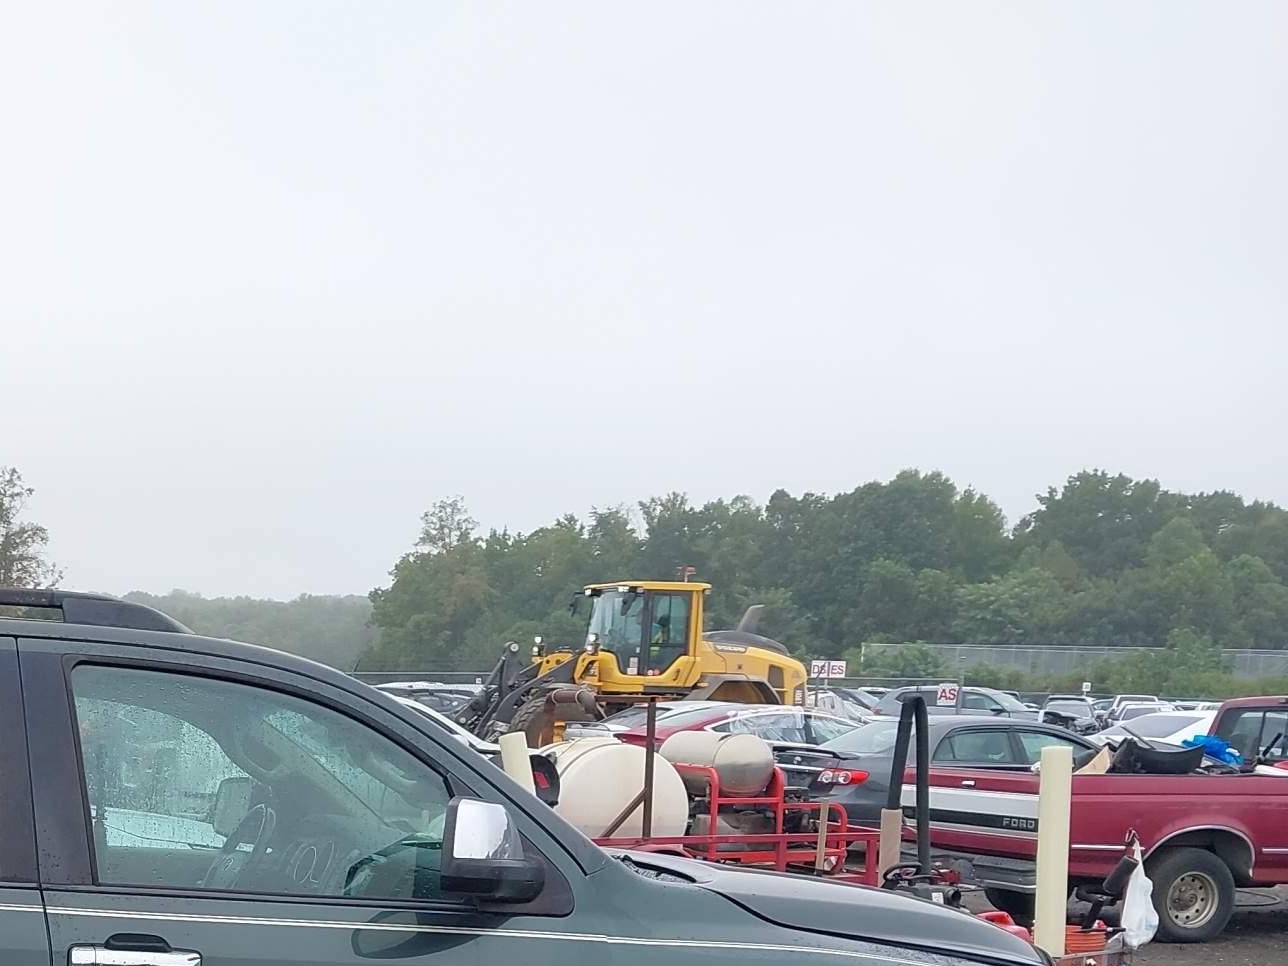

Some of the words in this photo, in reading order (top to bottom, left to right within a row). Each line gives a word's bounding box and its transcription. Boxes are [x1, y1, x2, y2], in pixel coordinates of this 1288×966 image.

[831, 664, 844, 674] ES
[938, 688, 957, 701] AS
[1002, 817, 1035, 829] FORD
